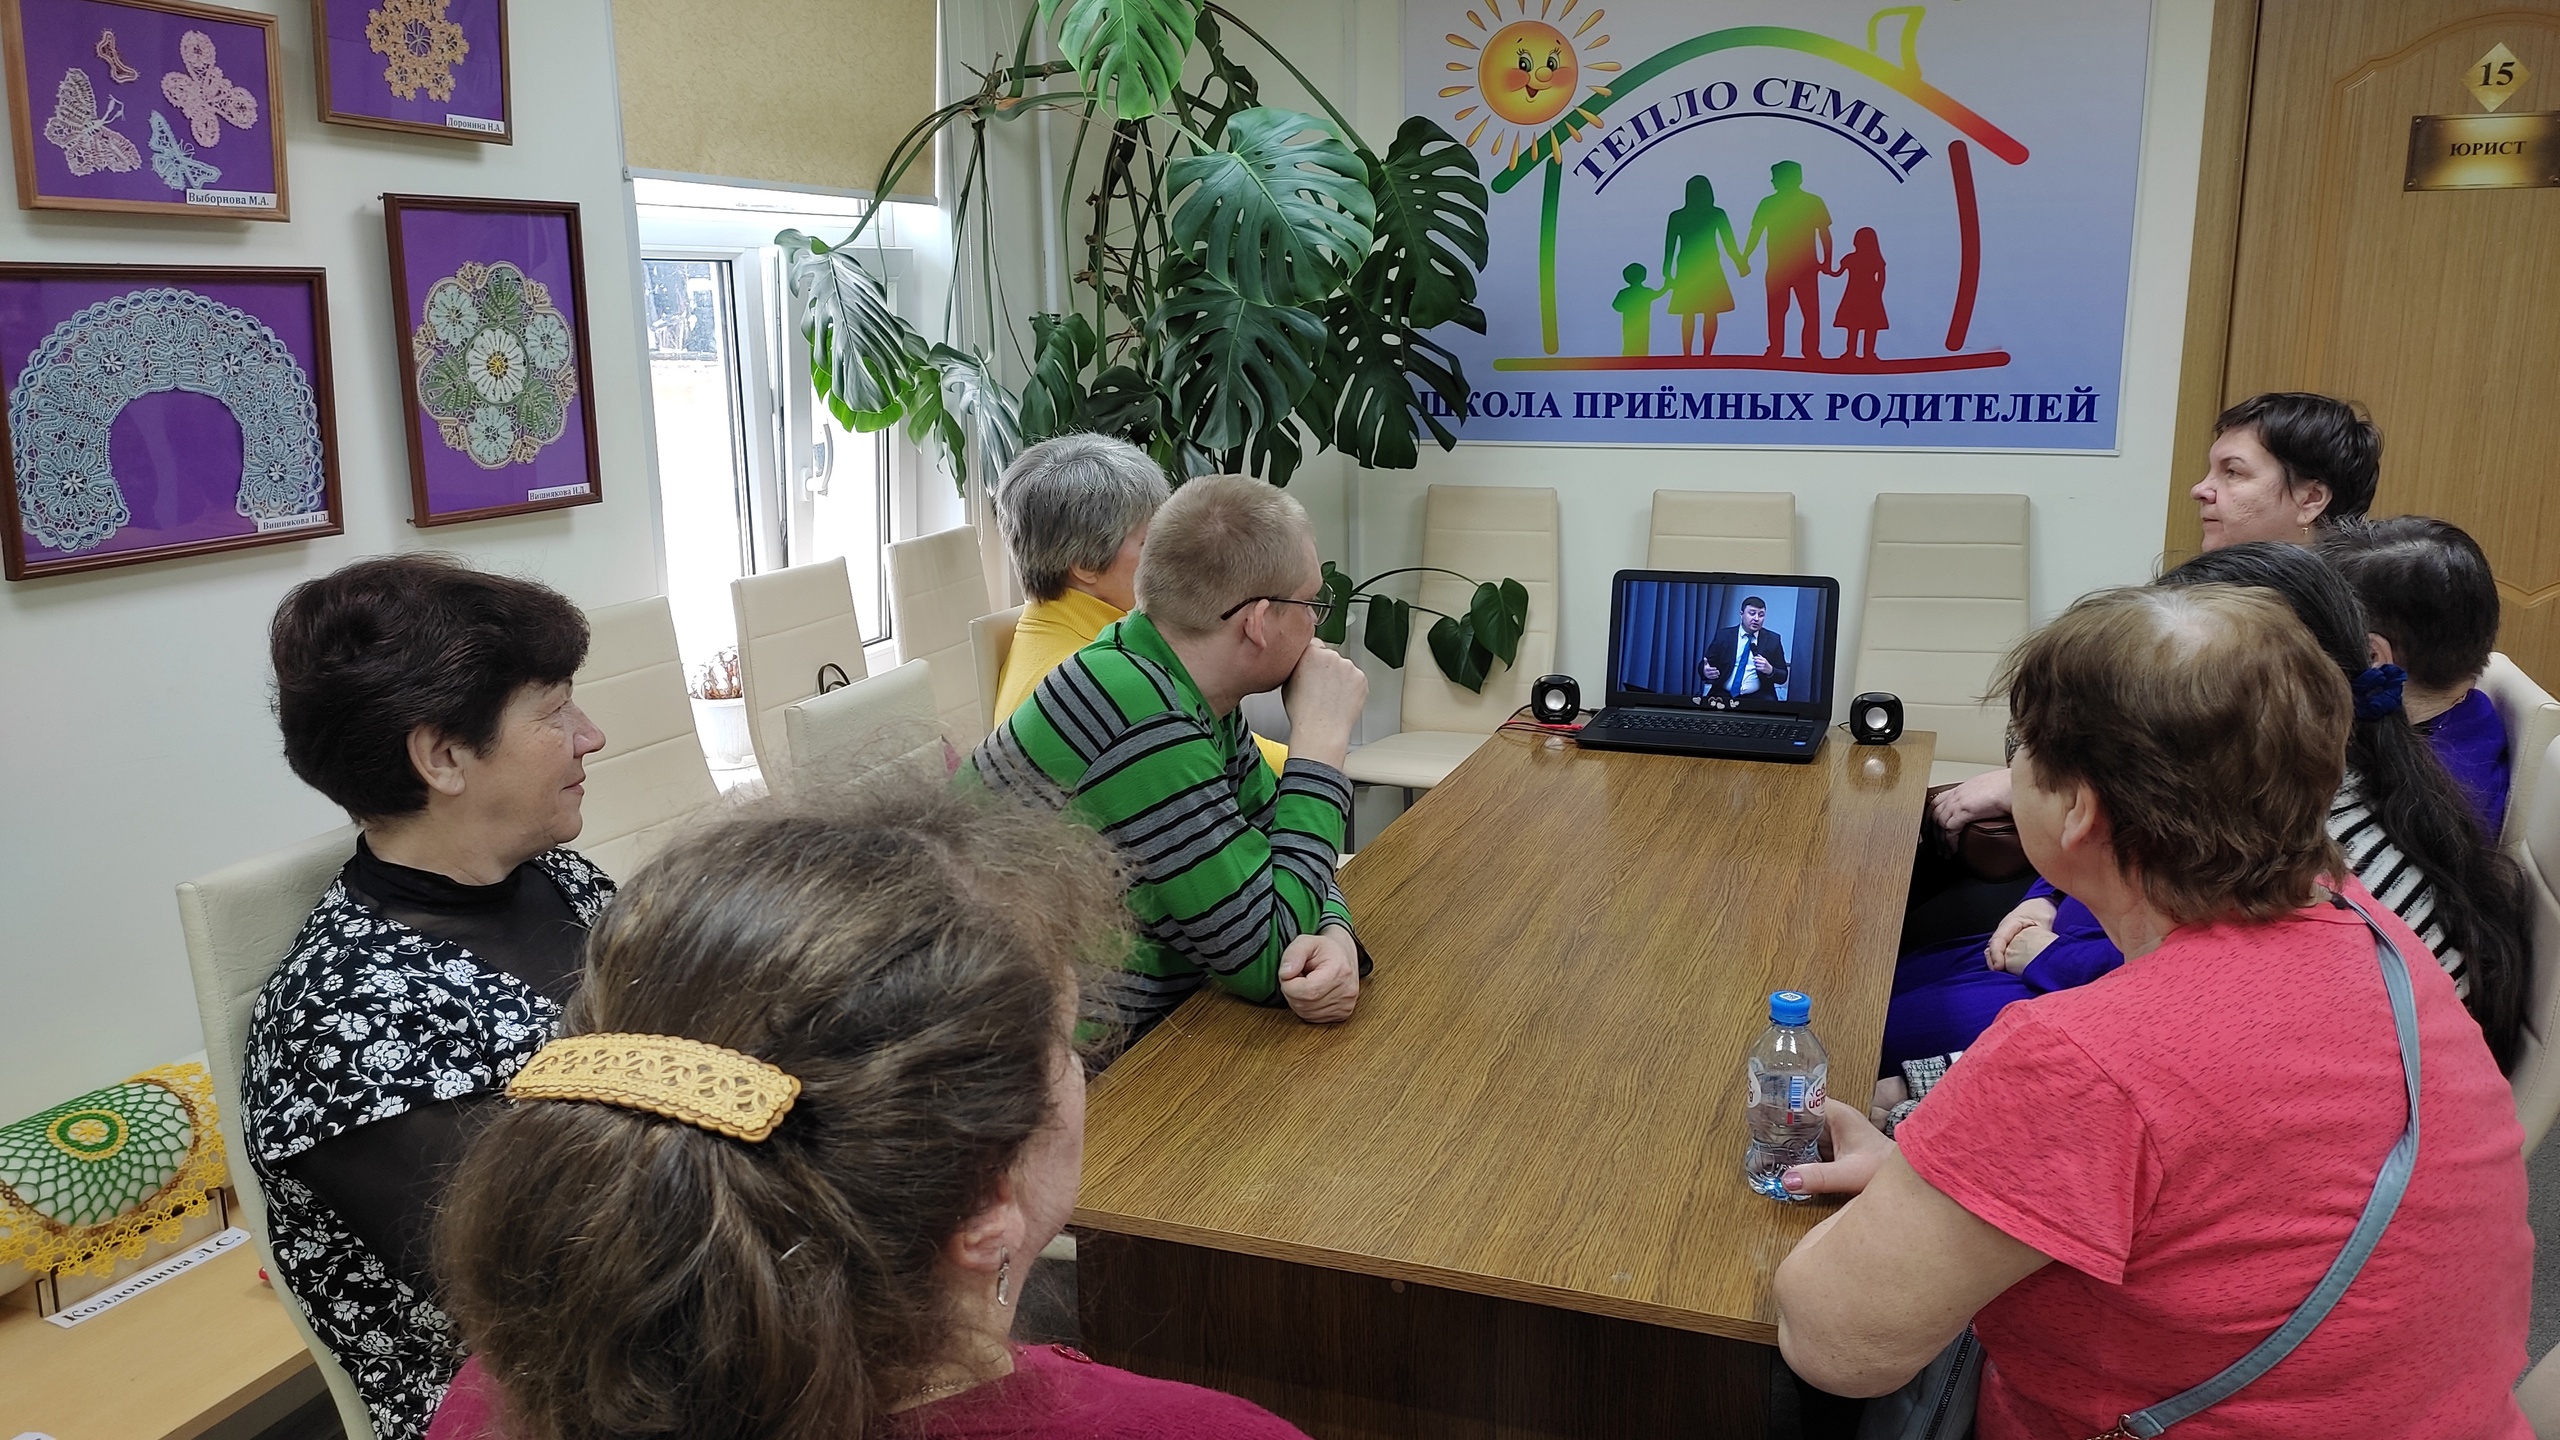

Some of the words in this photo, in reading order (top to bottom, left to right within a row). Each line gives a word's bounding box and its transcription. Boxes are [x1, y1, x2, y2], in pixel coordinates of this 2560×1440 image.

[2479, 61, 2515, 86] 15
[448, 117, 486, 130] Доронина
[1572, 81, 1738, 183] ТЕПЛО
[1753, 77, 1933, 176] СЕМЬИ
[2449, 140, 2527, 157] ЮРИСТ
[188, 192, 247, 206] Выборнова
[249, 195, 269, 206] М.А.
[1573, 385, 1815, 421] ПРИЁМНЫХ
[1825, 384, 2100, 429] РОДИТЕЛЕЙ
[529, 489, 571, 501] Вишнякова
[263, 517, 310, 530] Вишнякова
[197, 1234, 242, 1260] Л.С.
